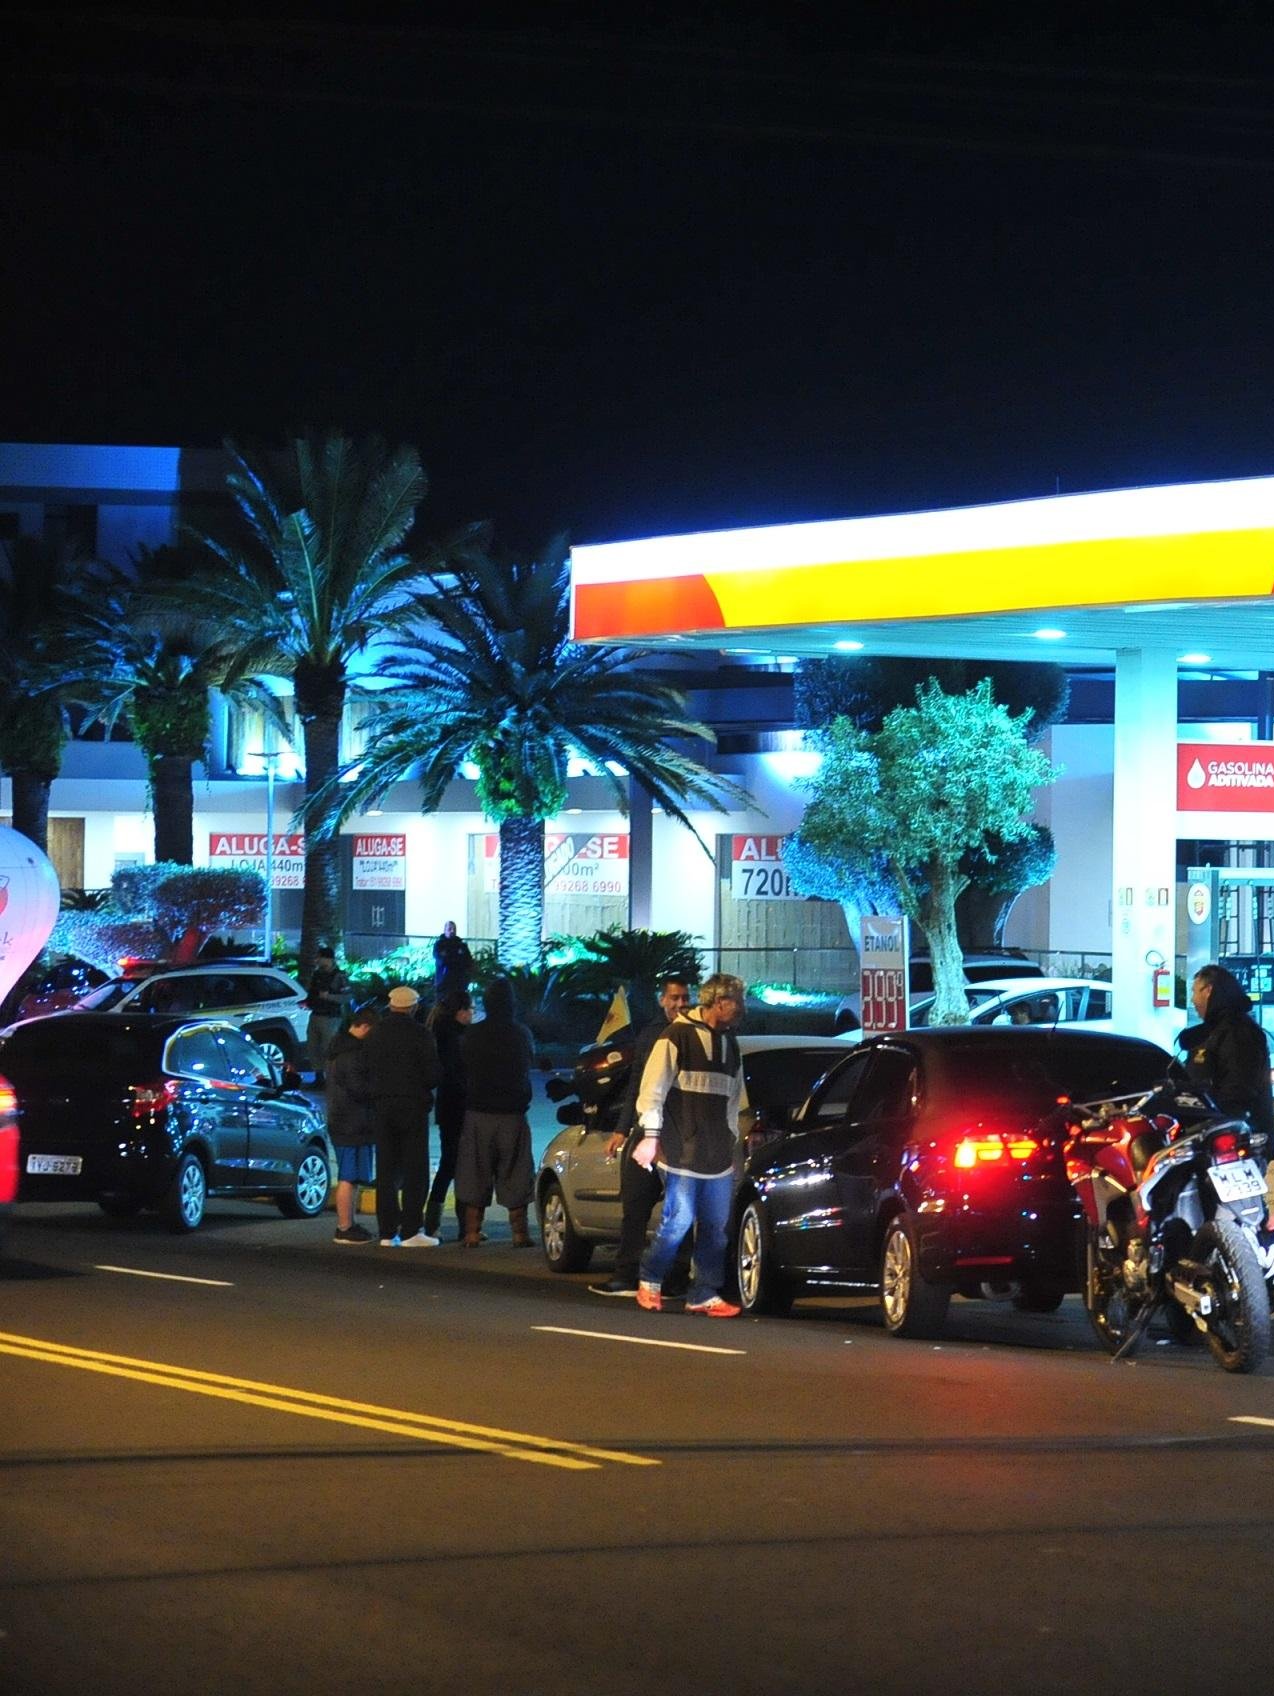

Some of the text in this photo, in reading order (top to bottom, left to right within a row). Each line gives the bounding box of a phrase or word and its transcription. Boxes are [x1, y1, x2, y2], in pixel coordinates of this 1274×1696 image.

[1208, 761, 1274, 775] GASOLINA
[1208, 774, 1274, 788] ADITIVADA
[355, 837, 404, 856] ALUGA-SE
